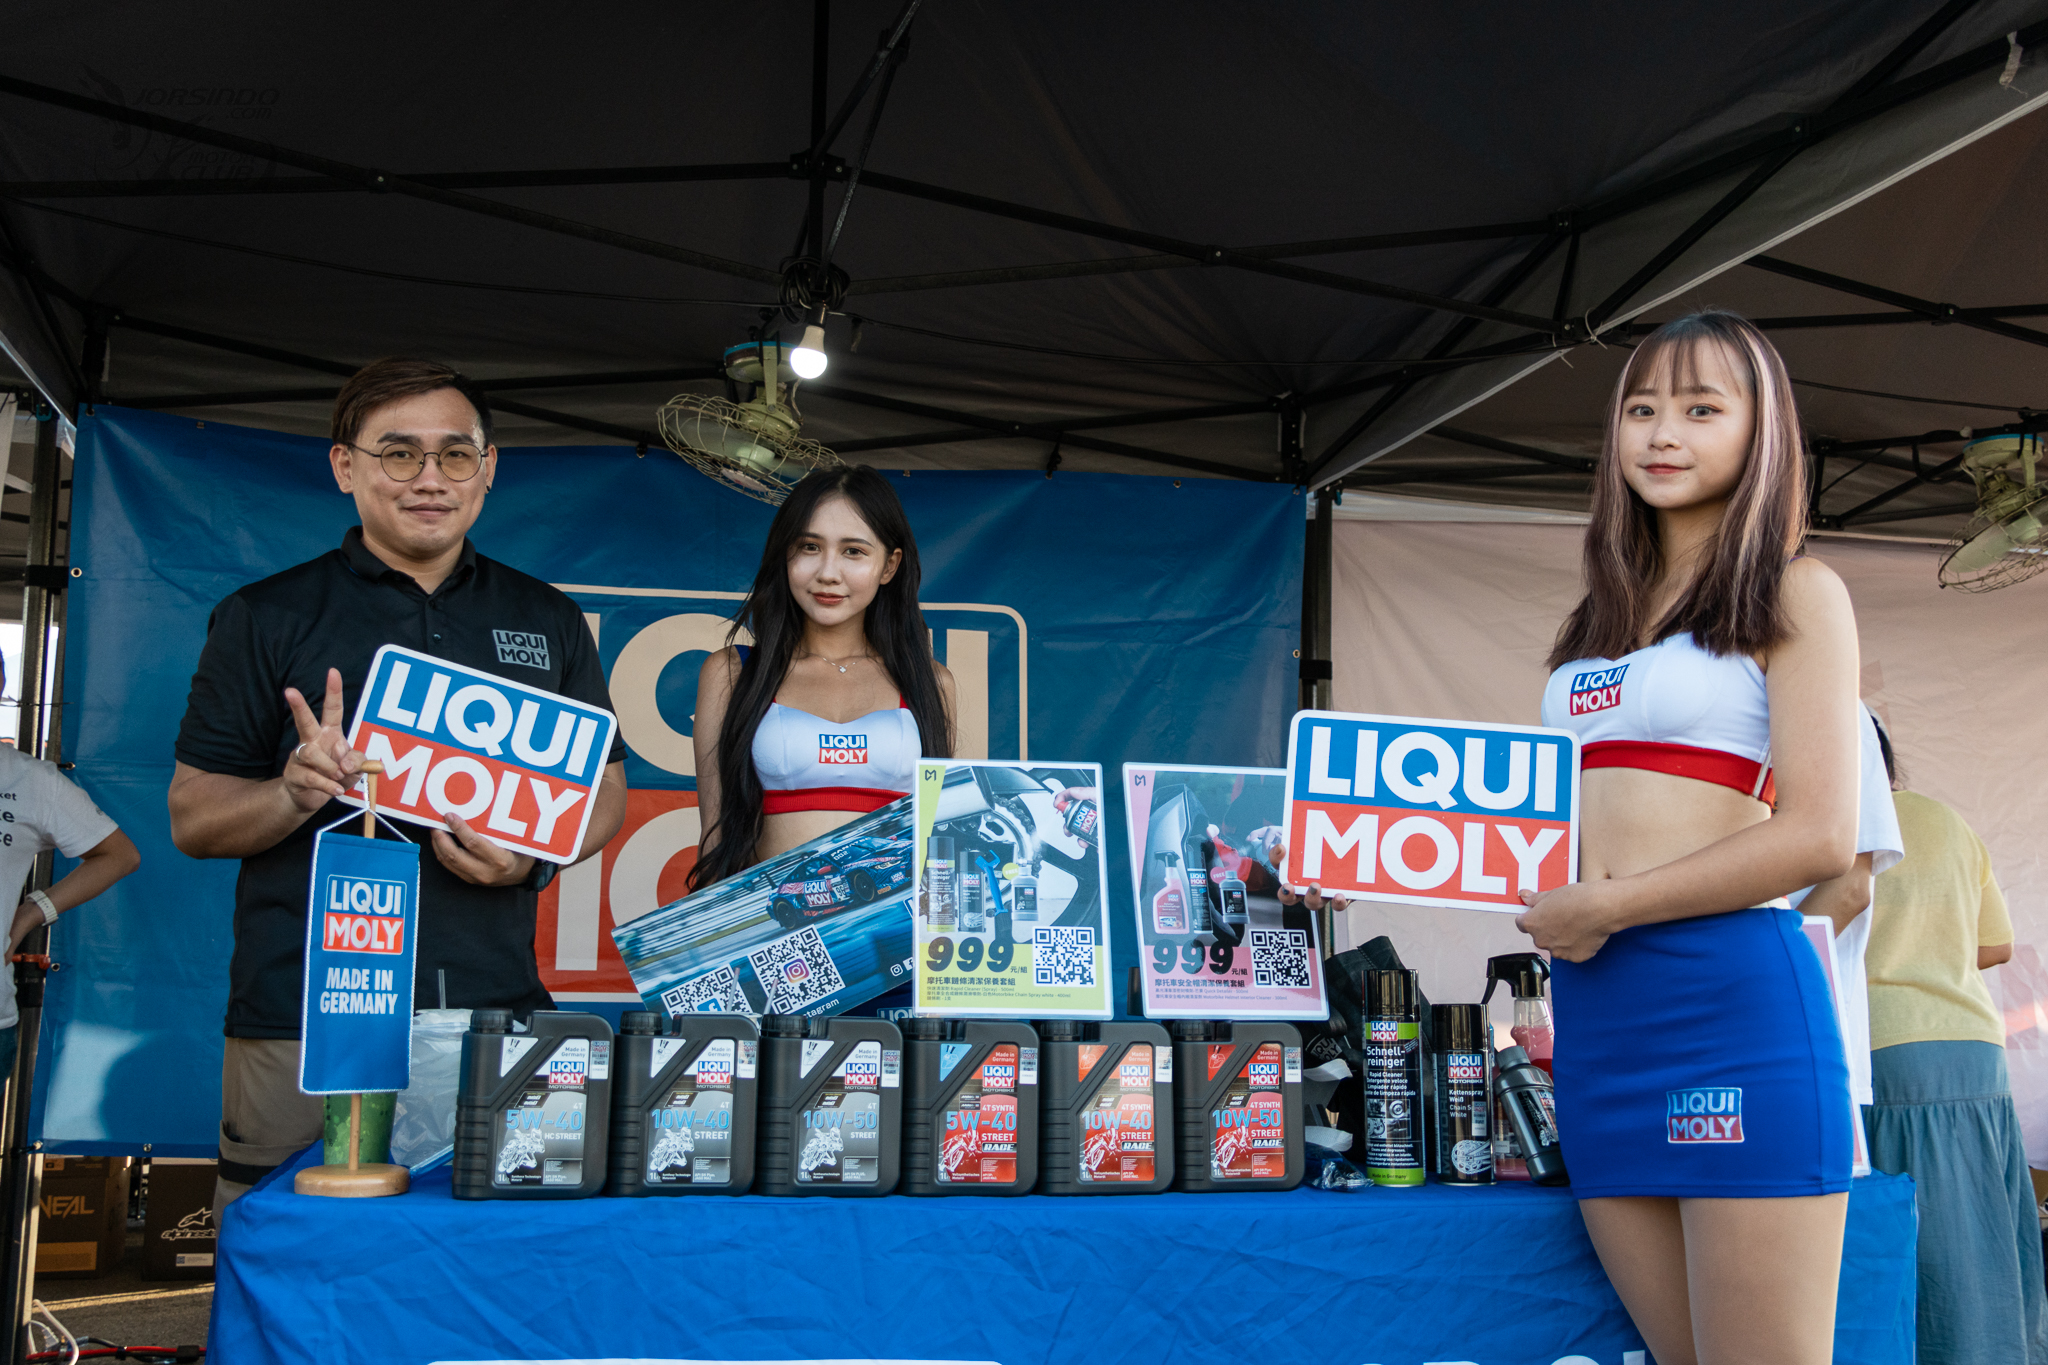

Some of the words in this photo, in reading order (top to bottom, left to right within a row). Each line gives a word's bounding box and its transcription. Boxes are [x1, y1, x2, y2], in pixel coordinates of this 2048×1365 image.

[496, 631, 545, 650] LIQUI
[500, 648, 547, 667] MOLY
[1574, 666, 1626, 691] LIQUI
[1573, 685, 1620, 713] MOLY
[377, 660, 598, 777] LIQUI
[821, 735, 865, 749] LIQUI
[821, 749, 867, 763] MOLY
[1308, 726, 1558, 812] LIQUI
[354, 732, 586, 844] MOLY
[1302, 809, 1566, 896] MOLY
[804, 880, 827, 893] LIQUI
[330, 880, 402, 915] LIQUI
[807, 893, 832, 906] MOLY
[328, 916, 402, 950] MOLY
[926, 936, 1014, 972] 999
[1153, 939, 1234, 975] 999
[326, 967, 370, 990] MADE
[375, 969, 393, 991] IN
[320, 991, 398, 1014] GERMANY
[1372, 1022, 1396, 1030] LIQUI
[1372, 1031, 1397, 1040] MOLY
[1367, 1046, 1405, 1055] Schnell-
[551, 1062, 584, 1072] LIQUI
[699, 1062, 729, 1072] LIQUI
[1368, 1057, 1405, 1068] reiniger
[1450, 1055, 1480, 1066] LIQUI
[847, 1064, 876, 1074] LIQUI
[984, 1066, 1013, 1076] LIQUI
[1122, 1066, 1148, 1076] LIQUI
[1250, 1064, 1277, 1074] LIQUI
[1450, 1067, 1481, 1077] MOLY
[550, 1074, 584, 1083] MOLY
[698, 1074, 730, 1084] MOLY
[846, 1075, 877, 1084] MOLY
[983, 1078, 1014, 1087] MOLY
[1121, 1077, 1149, 1086] MOLY
[1250, 1075, 1278, 1084] MOLY
[1449, 1089, 1483, 1097] Kettenspray
[1672, 1092, 1735, 1113] LIQUI
[506, 1110, 583, 1130] 5W-40
[652, 1109, 730, 1130] 10W-40
[804, 1110, 877, 1130] 10W-50
[946, 1111, 1016, 1131] 5W-40
[1082, 1111, 1151, 1130] 10W-40
[1212, 1110, 1281, 1128] 10W-50
[1672, 1117, 1737, 1139] MOLY
[694, 1131, 729, 1140] STREET
[982, 1133, 1014, 1141] STREET
